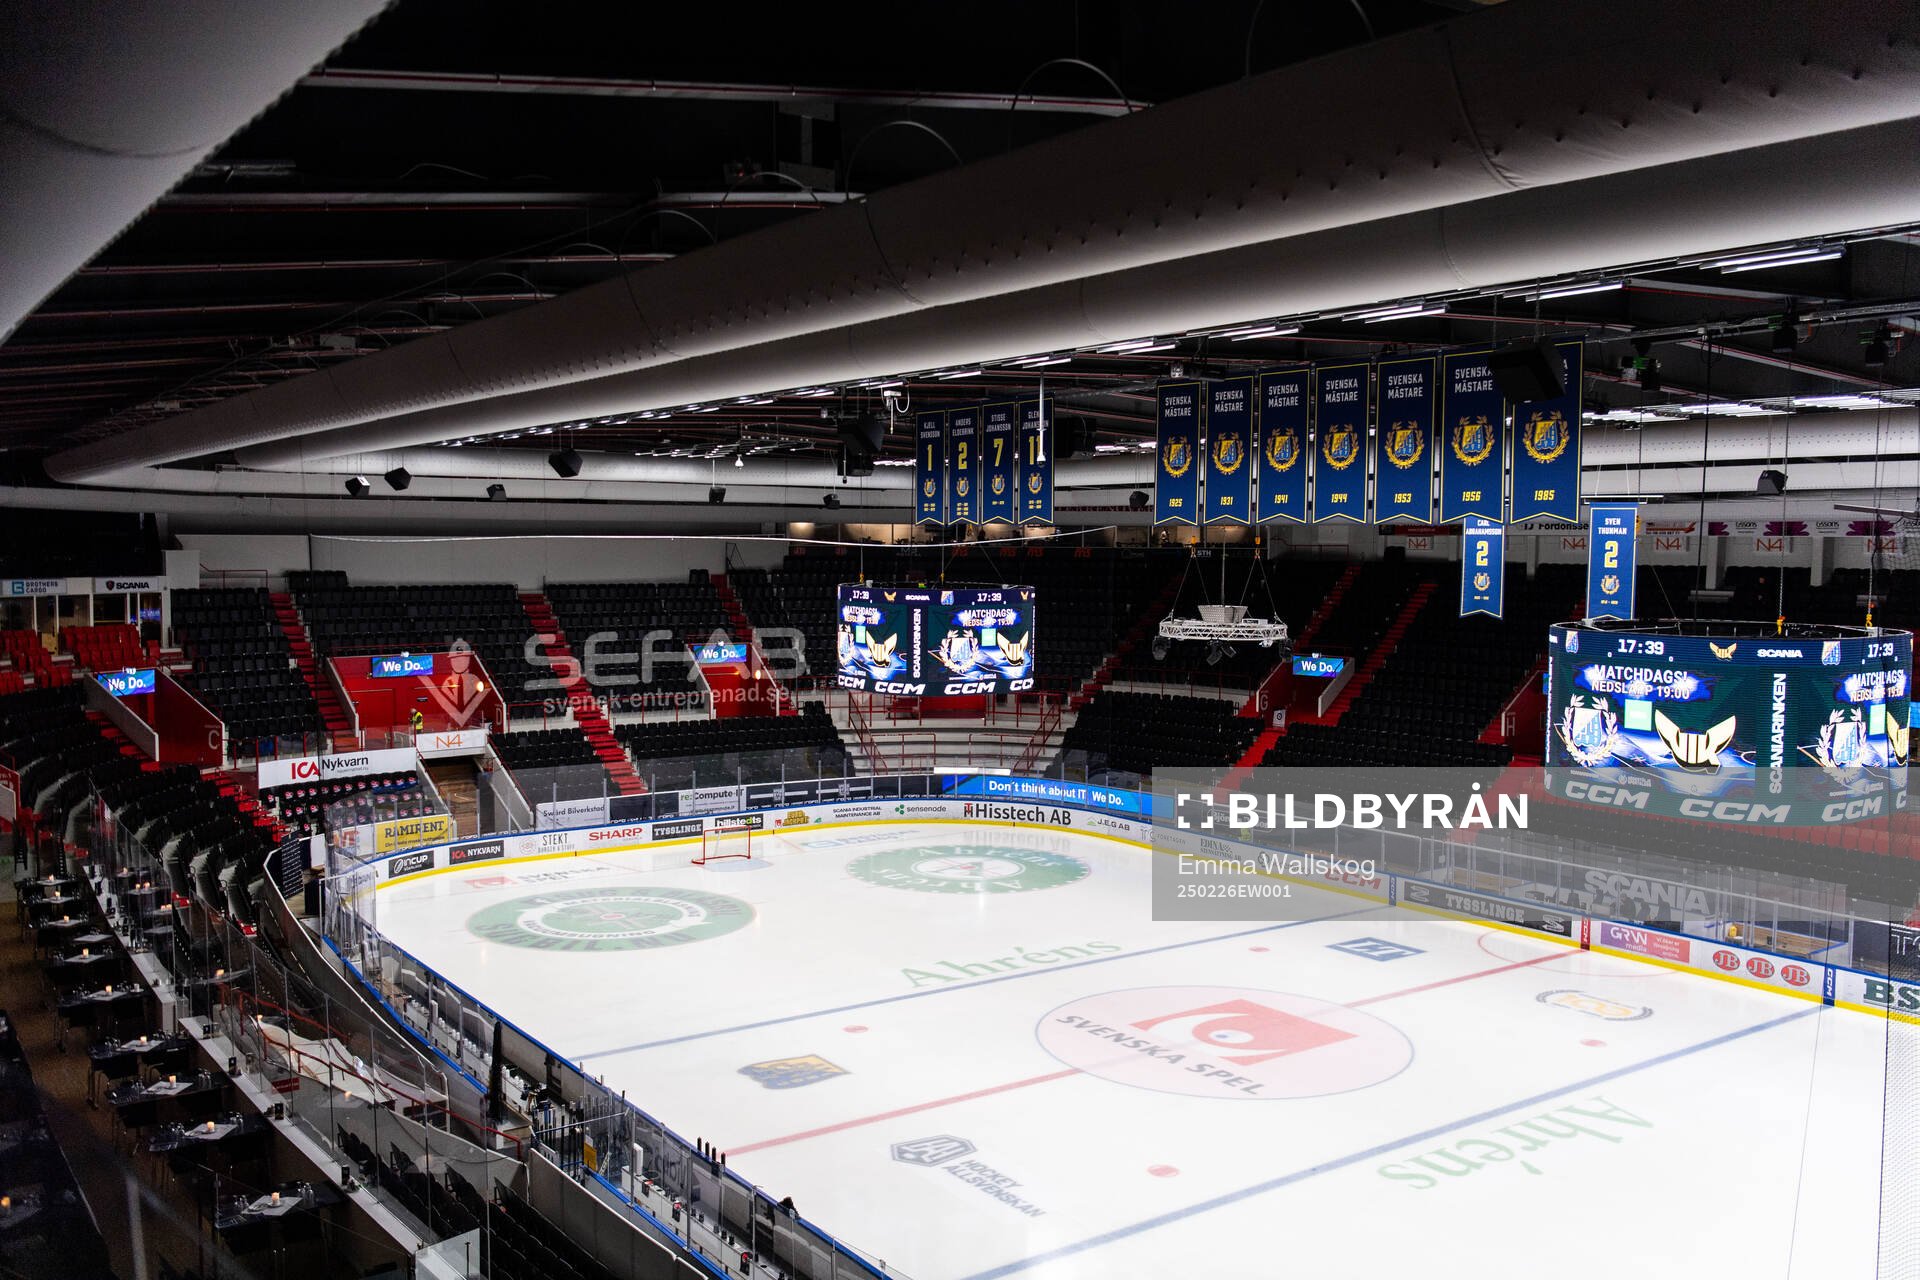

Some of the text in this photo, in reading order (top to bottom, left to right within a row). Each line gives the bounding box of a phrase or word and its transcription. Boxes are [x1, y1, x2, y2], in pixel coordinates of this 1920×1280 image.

[1325, 378, 1358, 390] SVENSKA
[1388, 373, 1423, 386] SVENSKA
[1454, 380, 1493, 393] MÄSTARE
[1215, 390, 1244, 400] SVENSKA
[1268, 383, 1299, 396] SVENSKA
[1388, 387, 1423, 399] MÄSTARE
[1165, 396, 1191, 406] SVENSKA
[1268, 396, 1299, 408] MÄSTARE
[1325, 391, 1359, 403] MÄSTARE
[1165, 407, 1191, 417] MÄSTARE
[1214, 401, 1244, 412] MÄSTARE
[927, 443, 933, 471] 1
[958, 442, 968, 470] 2
[993, 438, 1004, 467] 7
[1220, 496, 1234, 506] 1931
[1274, 494, 1289, 504] 1941
[1331, 493, 1348, 503] 1944
[1394, 493, 1412, 503] 1953
[1462, 491, 1481, 502] 1956
[1534, 489, 1555, 501] 1985
[1169, 498, 1183, 507] 1925
[1477, 519, 1490, 527] CARL
[1604, 517, 1621, 526] SVEN
[1476, 540, 1488, 566] 2
[1604, 540, 1618, 568] 2
[116, 581, 149, 589] SCANIA
[853, 590, 869, 600] 17:39
[977, 592, 1002, 602] 17:39
[964, 608, 1013, 619] MATCHDAGS!
[1618, 639, 1664, 654] 17:39
[1757, 649, 1803, 658] SCANIA
[1868, 643, 1893, 658] 17:39
[524, 628, 806, 691] SEFAB
[703, 649, 738, 659] We Do.
[382, 660, 423, 672] We Do.
[1301, 660, 1335, 672] We Do.
[1594, 664, 1688, 683] MATCHDAGS!
[108, 677, 146, 691] We Do.
[838, 675, 866, 690] CCM
[874, 681, 926, 695] CCM
[944, 681, 996, 695] CCM
[1657, 685, 1690, 699] 19:00
[208, 730, 220, 750] C
[1769, 673, 1786, 793] SCANIARINKEN
[436, 734, 463, 748] N4
[291, 756, 369, 780] ICA Nykvarn
[1021, 782, 1046, 794] think
[1049, 786, 1075, 798] about
[1092, 791, 1106, 803] We
[1108, 794, 1124, 806] Do.
[1565, 781, 1649, 809] CCM
[976, 803, 1071, 825] Hisstech AB
[1680, 798, 1791, 823] CCM
[1821, 796, 1882, 822] CCM
[385, 821, 445, 838] RAMIRENT
[654, 823, 703, 836] TYSSLINGE
[714, 817, 762, 829] hillstedts
[1118, 822, 1130, 831] AB
[543, 832, 568, 846] STEKT
[589, 828, 643, 841] SHARP
[451, 845, 502, 860] ICA NYKVARN
[1584, 870, 1713, 915] SCANIA
[1445, 894, 1524, 924] TYSSLINGE
[1610, 927, 1648, 945] GRW
[1625, 943, 1647, 952] media
[901, 938, 1122, 988] Ahréns
[1715, 952, 1740, 969] JB
[1749, 959, 1774, 977] JB
[1783, 967, 1809, 985] JB
[1056, 1013, 1264, 1095] SVENSKA SPEL
[1377, 1096, 1654, 1190] Ahréns
[960, 1159, 1022, 1190] HOCKEY
[945, 1165, 1045, 1219] ALLSVENSKAN
